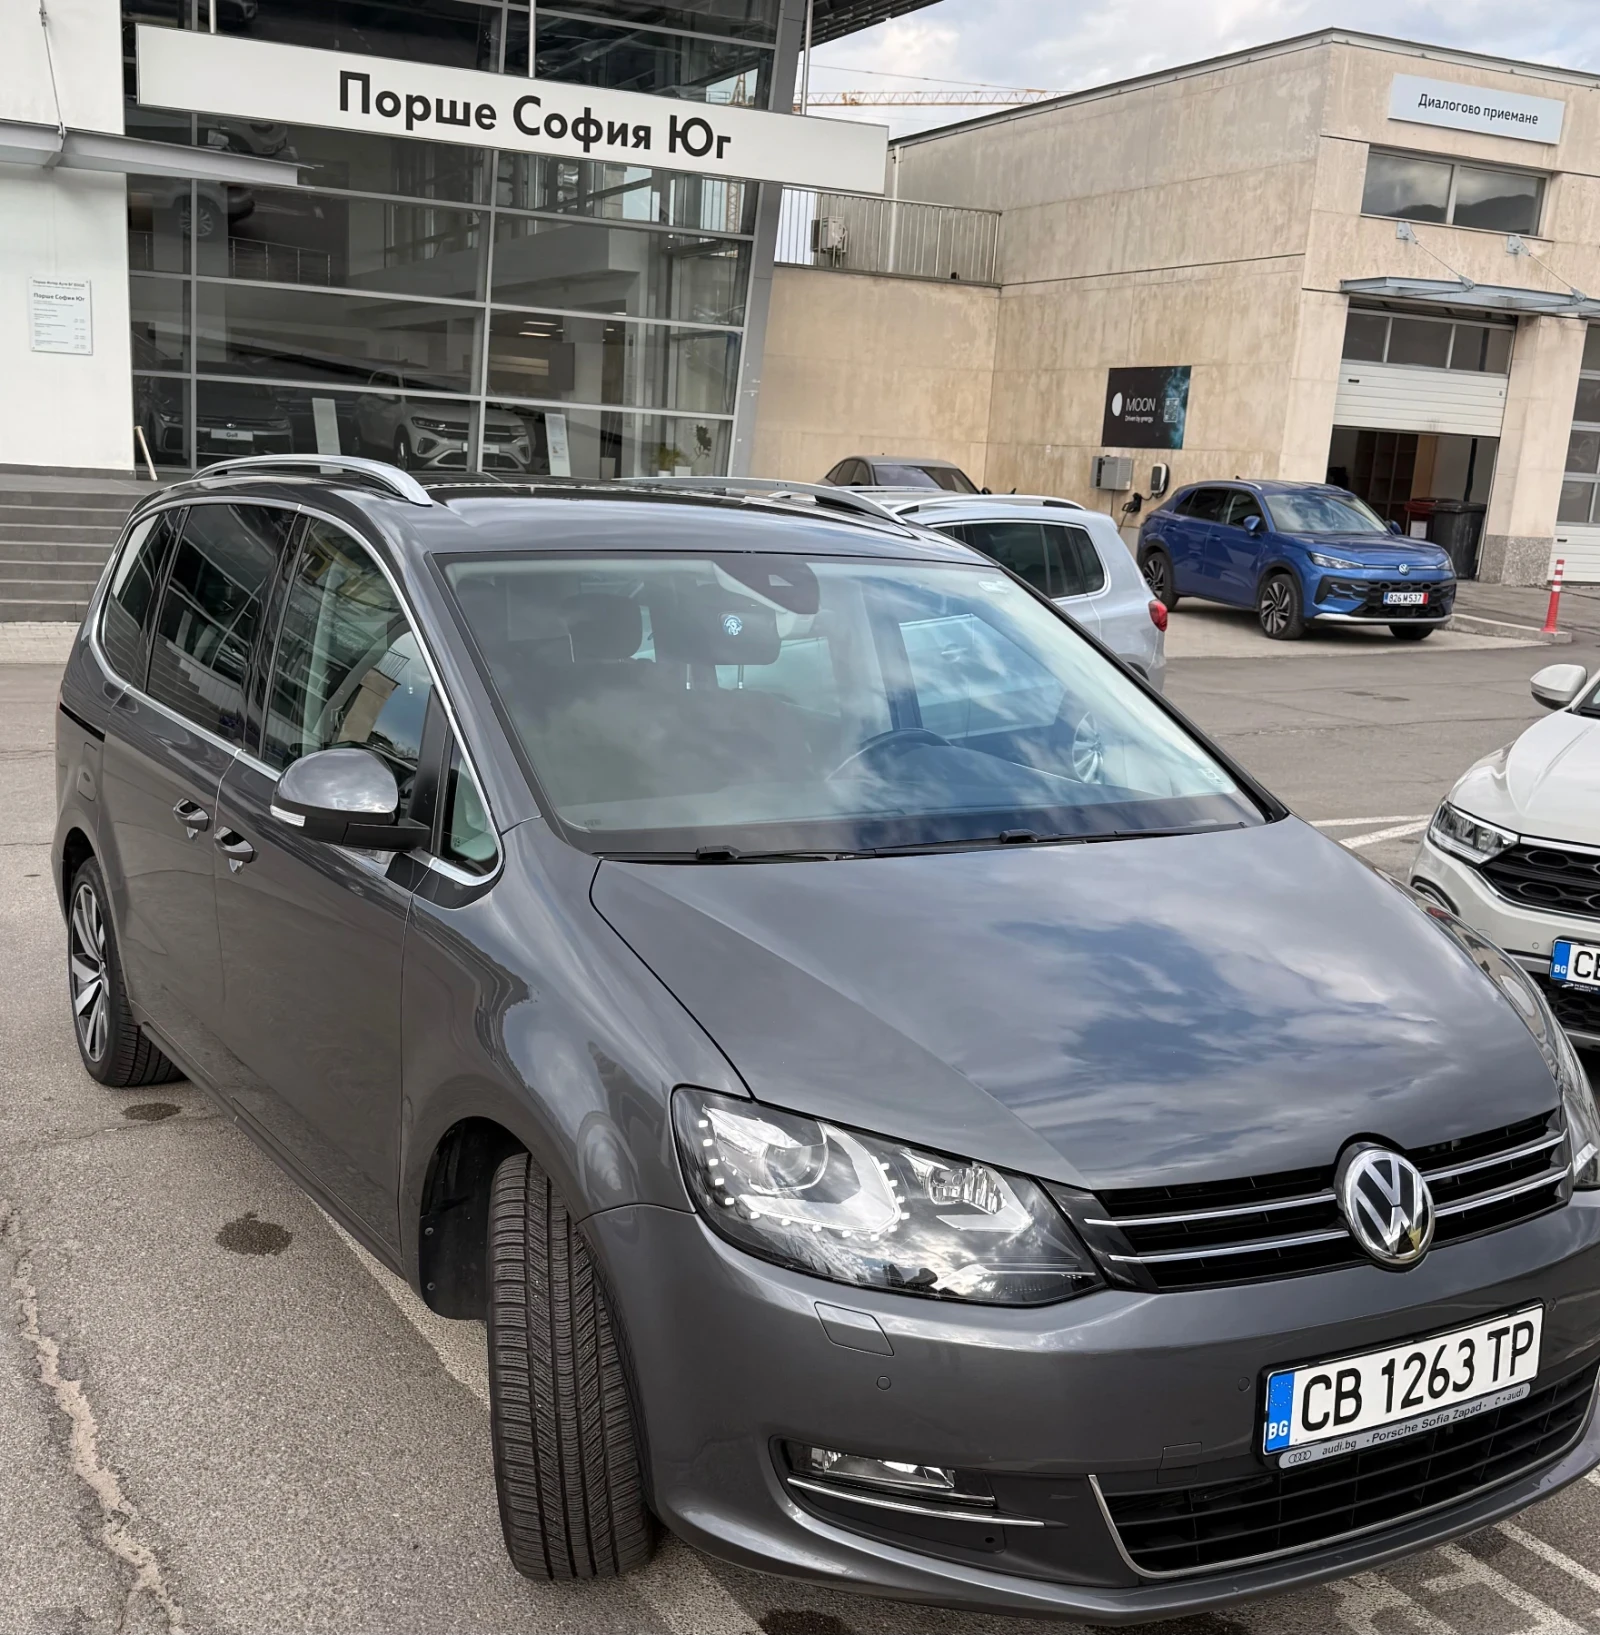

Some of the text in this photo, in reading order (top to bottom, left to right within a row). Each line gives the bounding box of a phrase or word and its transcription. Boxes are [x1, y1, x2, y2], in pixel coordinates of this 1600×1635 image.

[339, 70, 732, 159] Порше София Юг
[1418, 93, 1539, 125] Диалогово приемане
[33, 292, 54, 300] Порше
[1125, 397, 1156, 412] MOON
[1553, 964, 1567, 974] BG
[1301, 1320, 1535, 1432] CB 1263 TP
[1268, 1420, 1289, 1440] BG
[1322, 1438, 1357, 1455] audi.bg
[1421, 1412, 1450, 1429] Sofia
